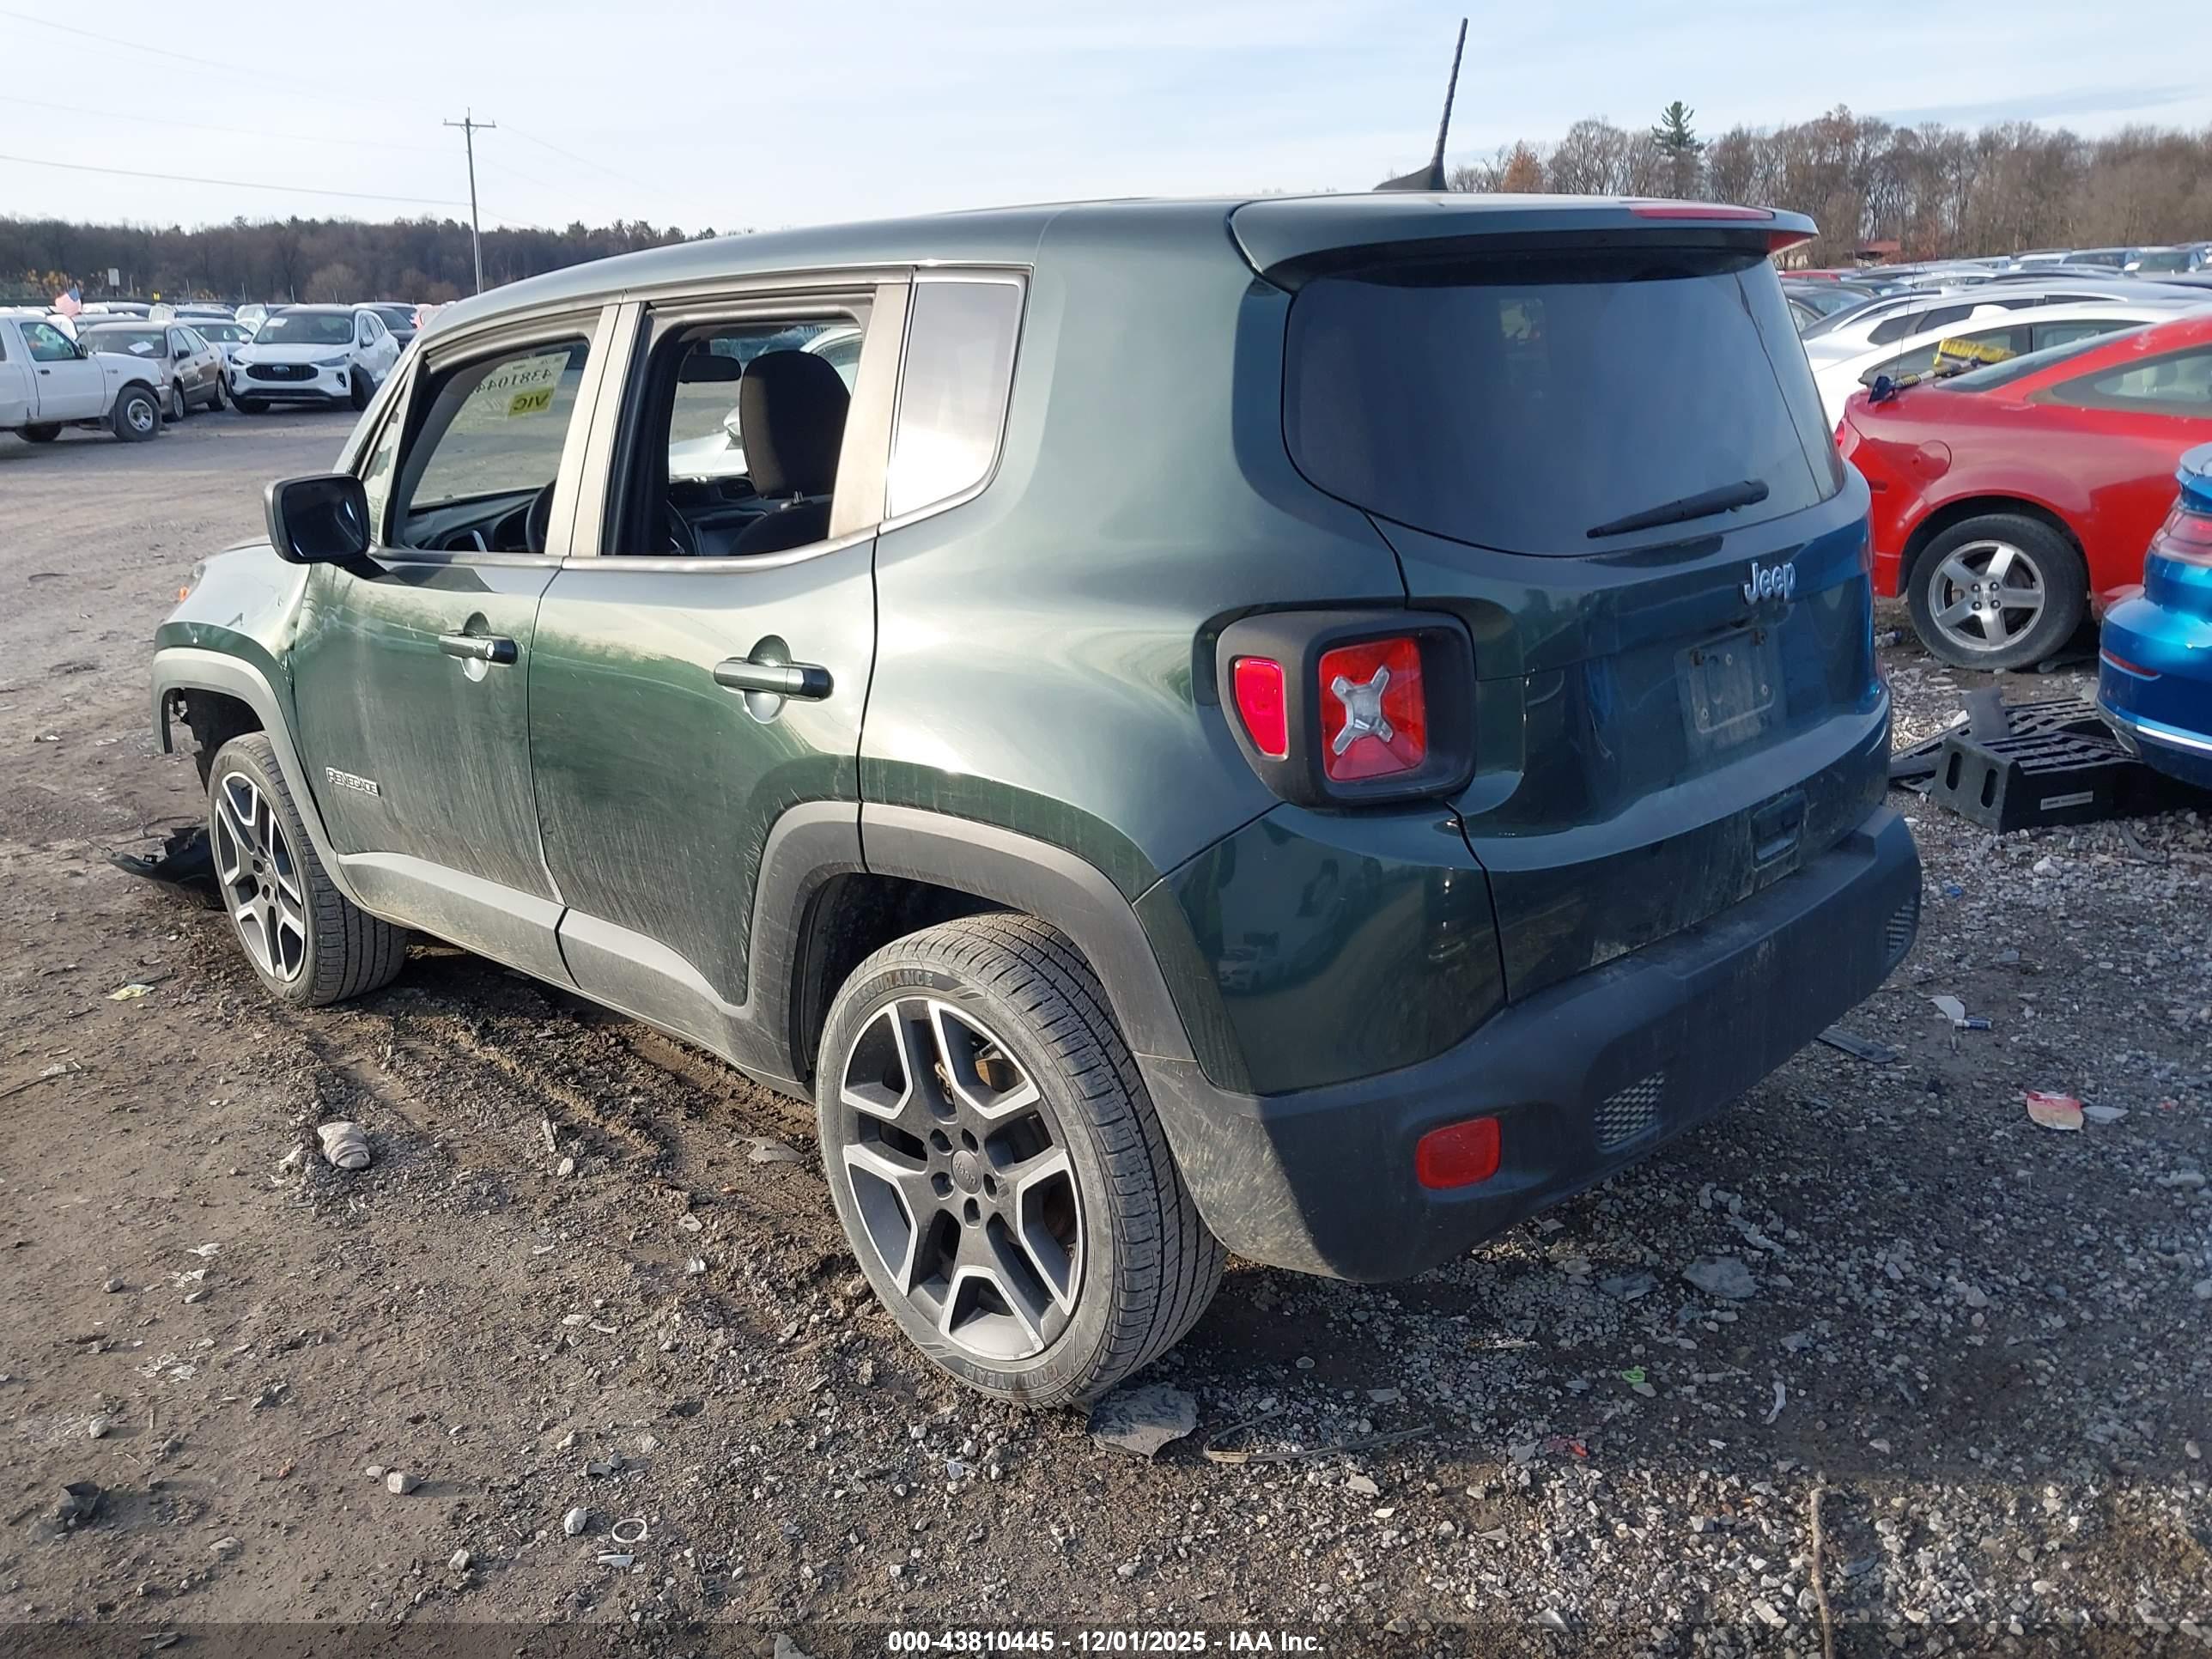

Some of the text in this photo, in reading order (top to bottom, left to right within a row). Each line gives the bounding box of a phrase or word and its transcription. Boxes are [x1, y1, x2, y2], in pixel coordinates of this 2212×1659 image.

[1744, 562, 1796, 605] Jeep
[325, 767, 380, 797] RENEGADE
[856, 970, 933, 1006] ASSURANCE
